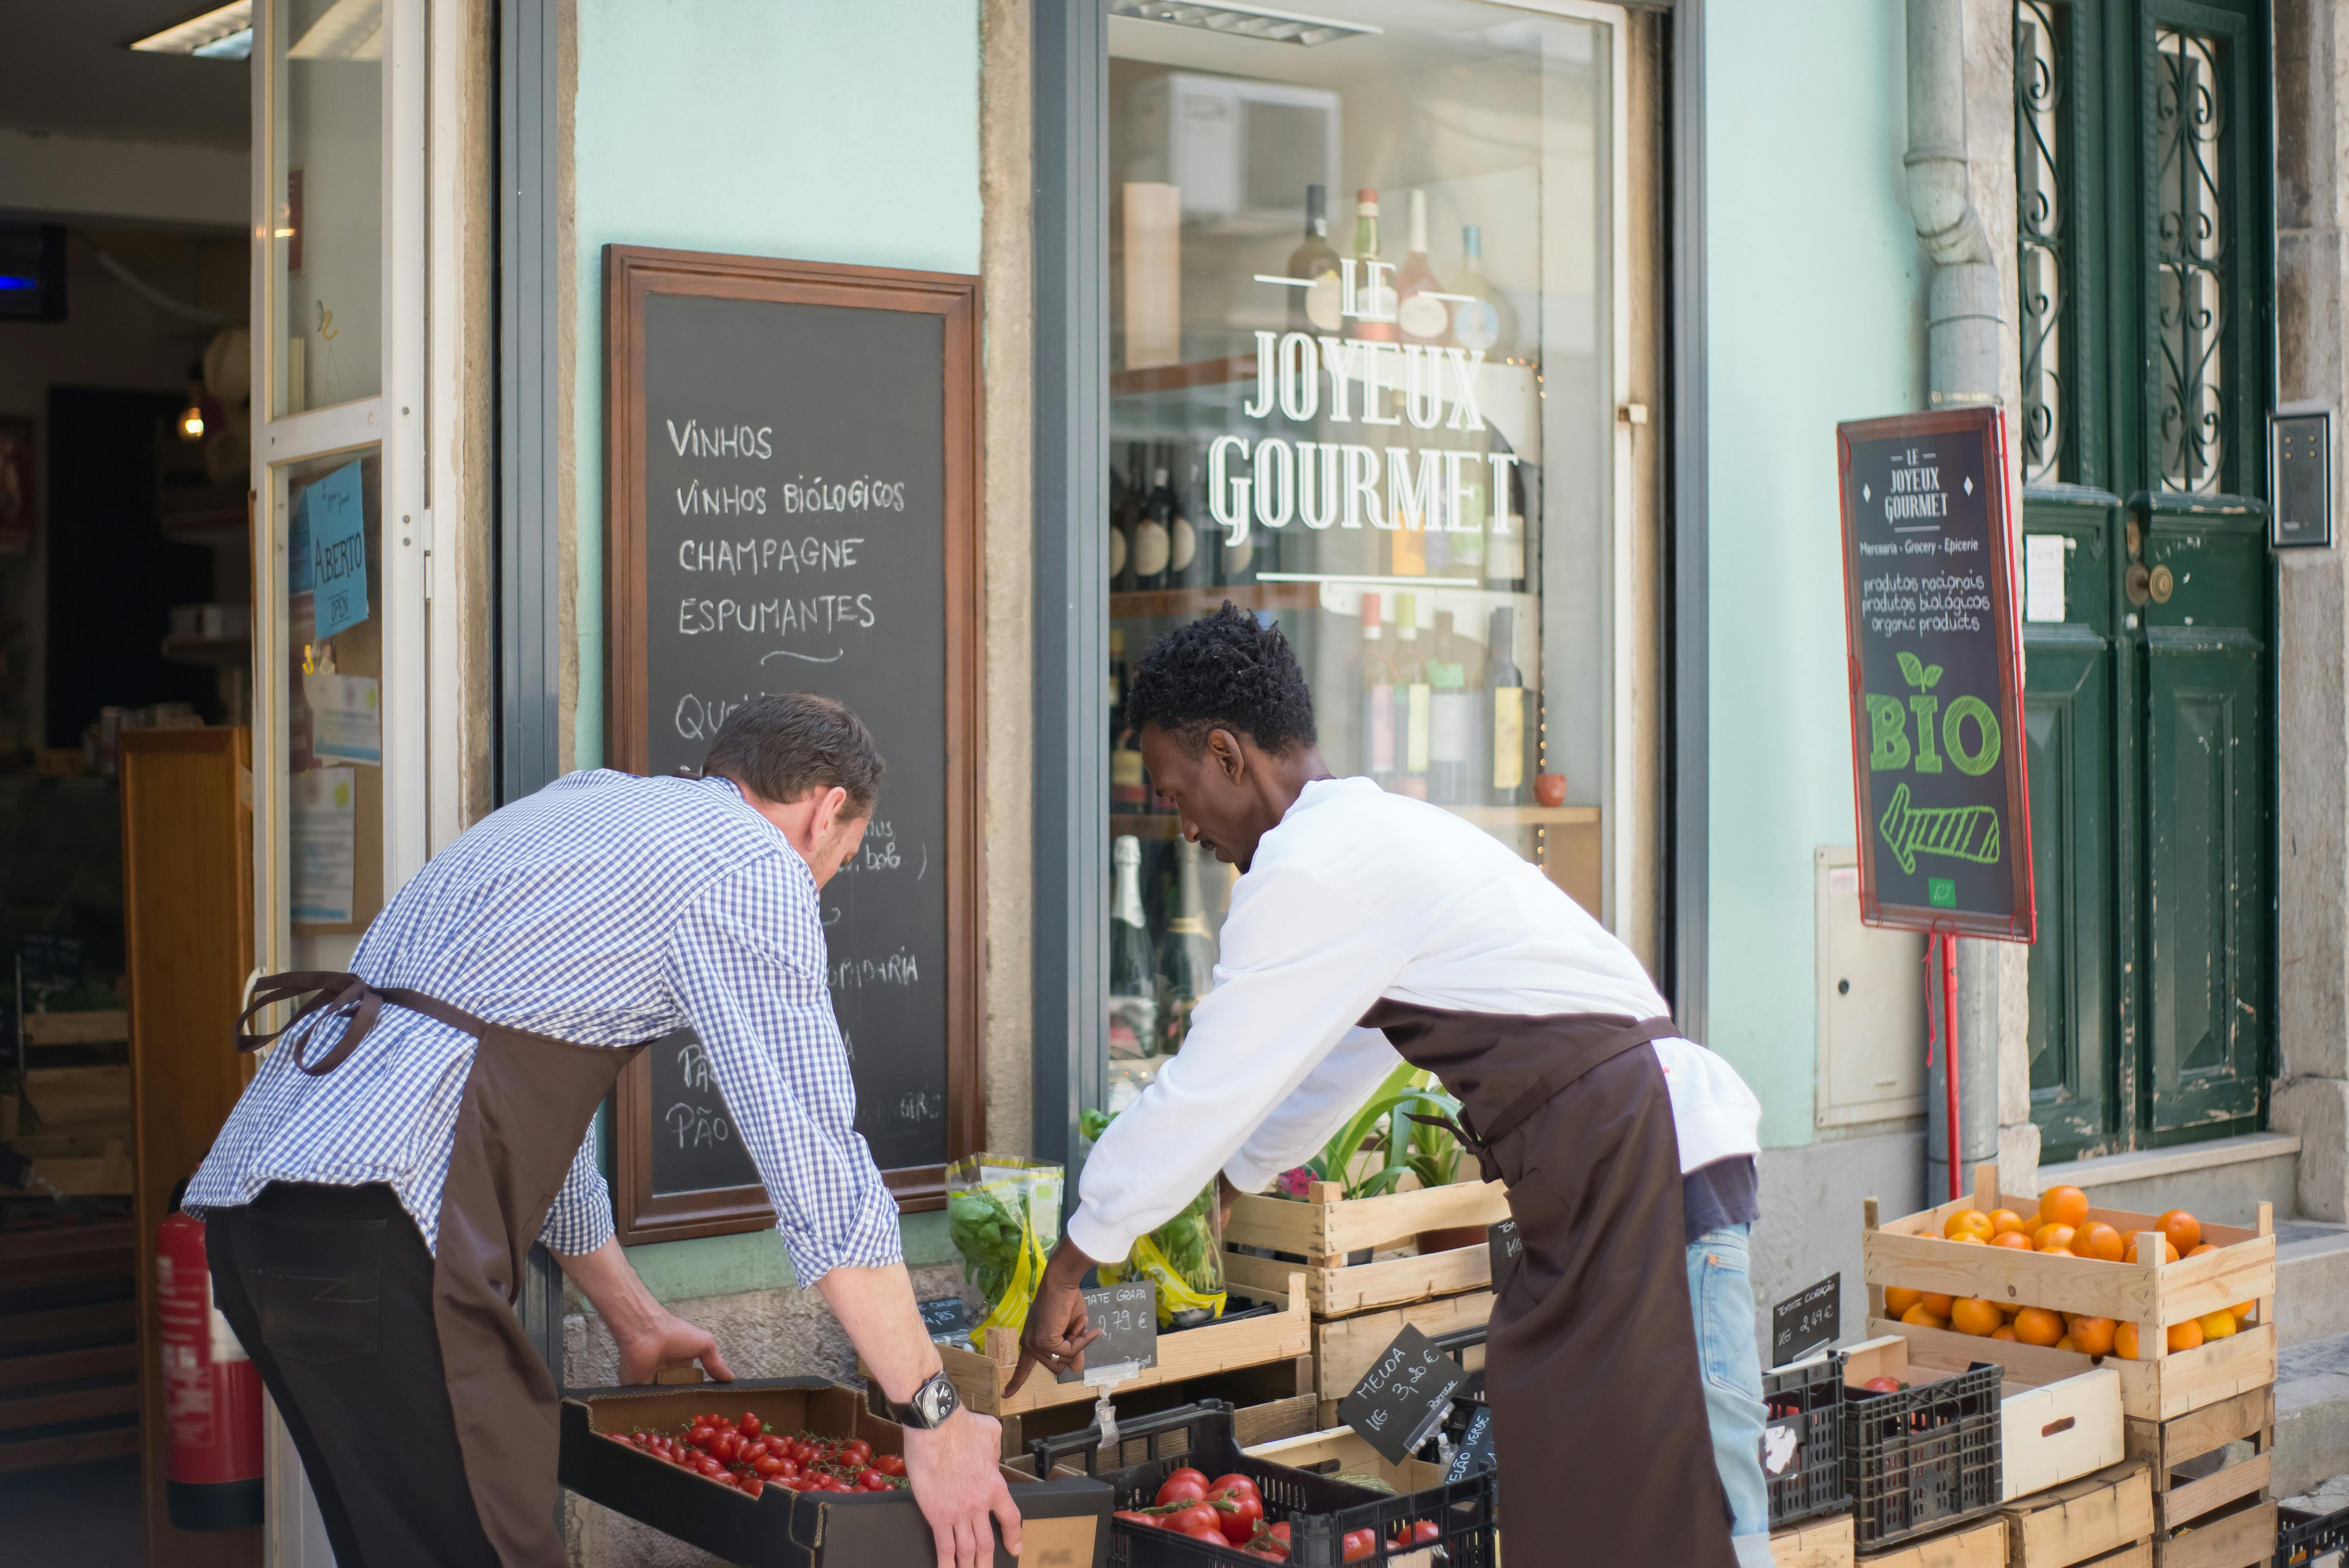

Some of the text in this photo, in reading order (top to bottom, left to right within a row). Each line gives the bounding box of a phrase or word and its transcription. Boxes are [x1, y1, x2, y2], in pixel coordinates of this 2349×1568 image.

[1340, 258, 1397, 322] LE
[1244, 331, 1486, 432] JOYEUX
[667, 419, 772, 460] VINHOS
[1906, 448, 1919, 466] LE
[1208, 435, 1519, 547] GOURMET
[1890, 466, 1941, 494] JOYEUX
[677, 479, 767, 517] VINHOS
[1884, 492, 1948, 525] GOURMET
[313, 532, 363, 589] ABERTO
[679, 537, 865, 575] CHAMPAGNE
[1859, 537, 1979, 557] Mercearia Grocery Epicerie
[1864, 569, 1985, 597] produtos nacionais
[331, 595, 349, 621] OPEN
[679, 594, 875, 635] ESPUMANTES
[1862, 589, 1990, 619] produtos biológicos
[1872, 610, 1980, 639] organic products
[665, 1102, 728, 1149] PÃO
[1116, 1289, 1146, 1302] GRAPA
[1778, 1328, 1792, 1346] KG
[1356, 1347, 1406, 1399] MELOA
[1365, 1409, 1388, 1431] KG
[1466, 1415, 1489, 1445] VERDE
